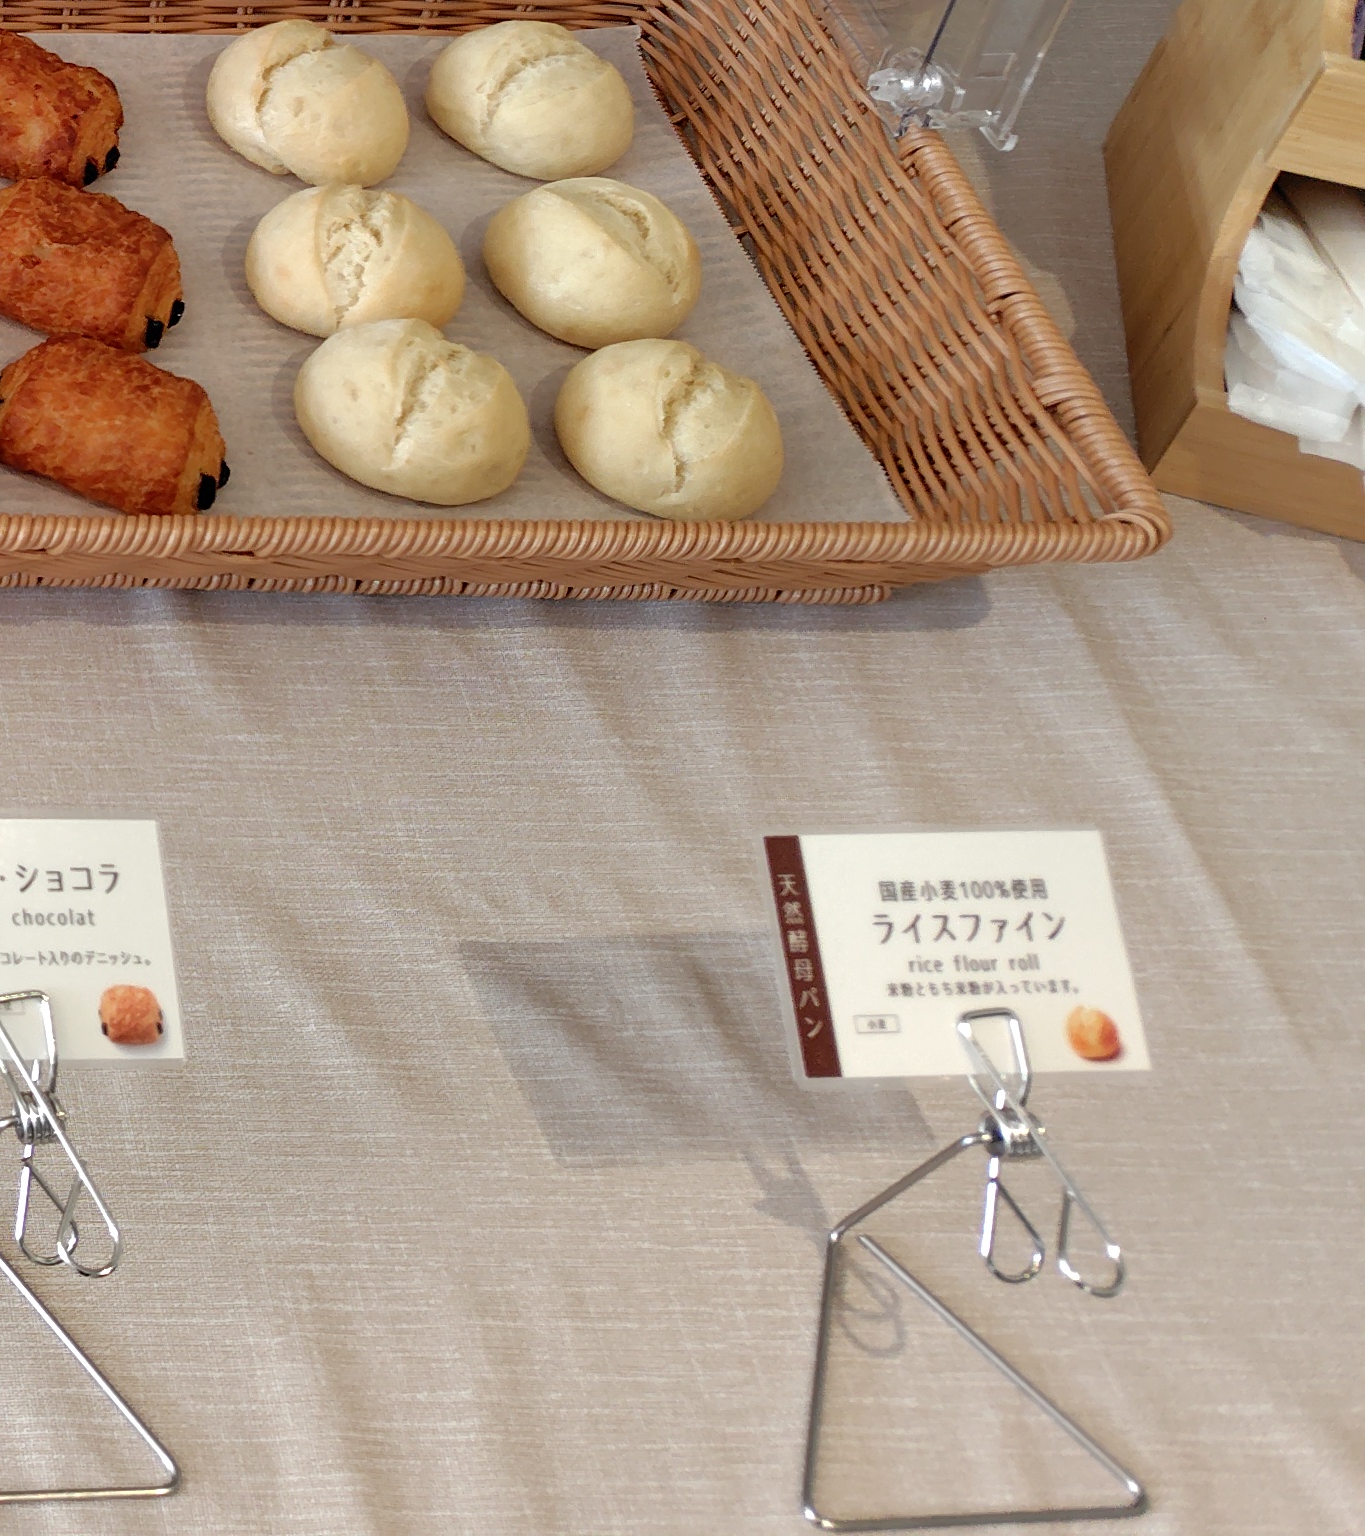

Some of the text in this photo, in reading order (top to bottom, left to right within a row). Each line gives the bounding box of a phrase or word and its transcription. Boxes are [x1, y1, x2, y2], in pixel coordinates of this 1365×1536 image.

[879, 879, 1049, 902] 国産小麦100%使用
[12, 908, 96, 926] chocolat
[872, 911, 1066, 944] ライスファイン
[776, 874, 823, 1039] 天然酵母パン
[908, 954, 1040, 973] rice flour roll
